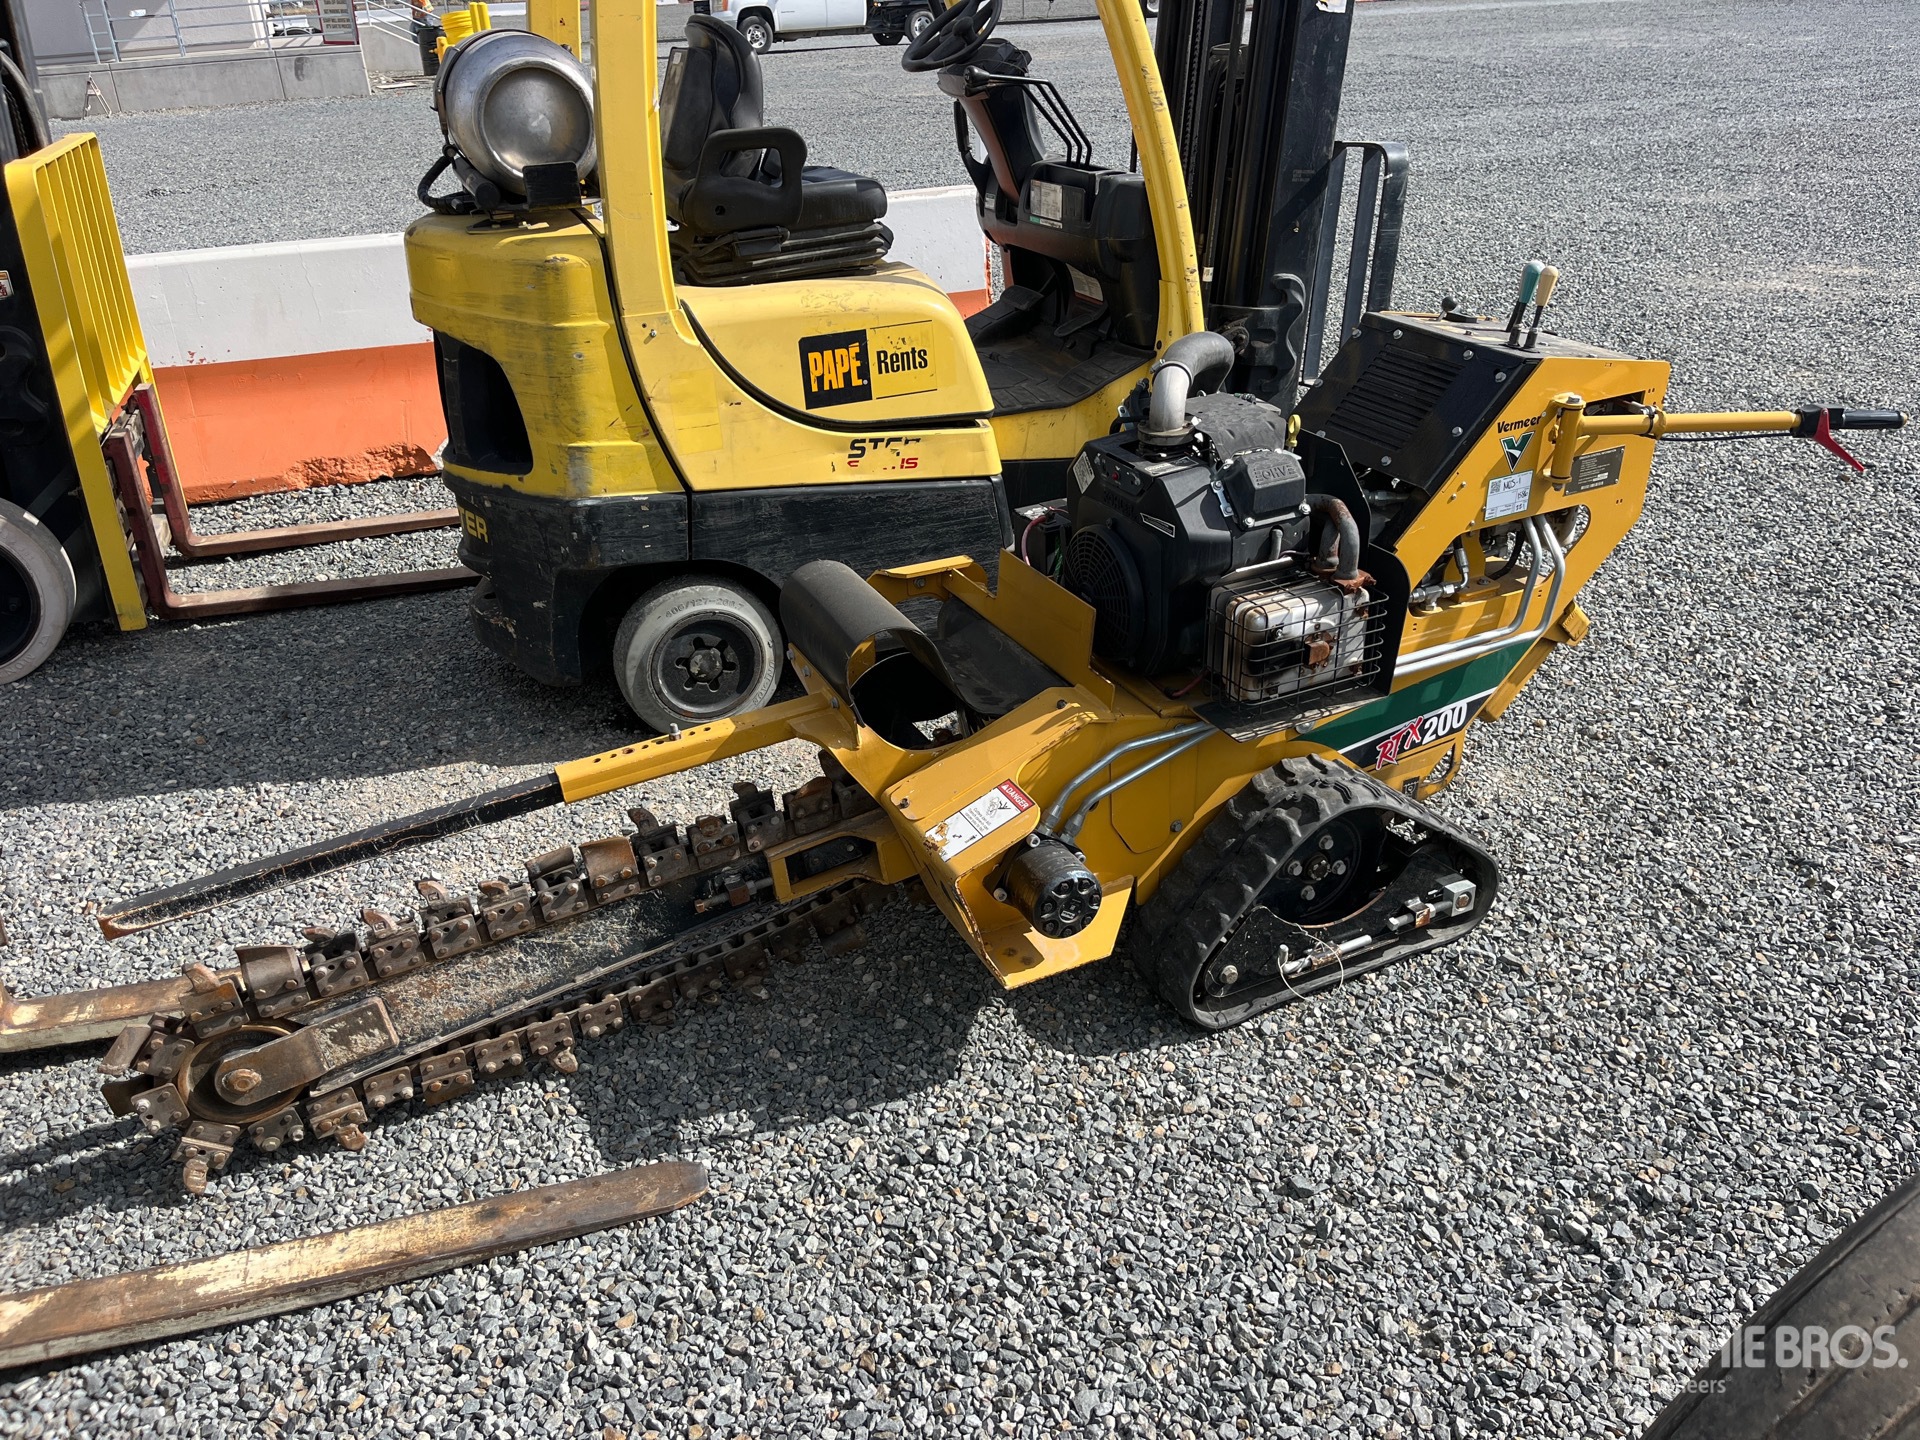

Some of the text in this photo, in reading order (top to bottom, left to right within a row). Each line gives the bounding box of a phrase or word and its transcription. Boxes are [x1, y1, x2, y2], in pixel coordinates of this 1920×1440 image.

[876, 346, 928, 375] Rents
[1497, 415, 1541, 434] Vermeer
[1005, 787, 1029, 809] DANGER
